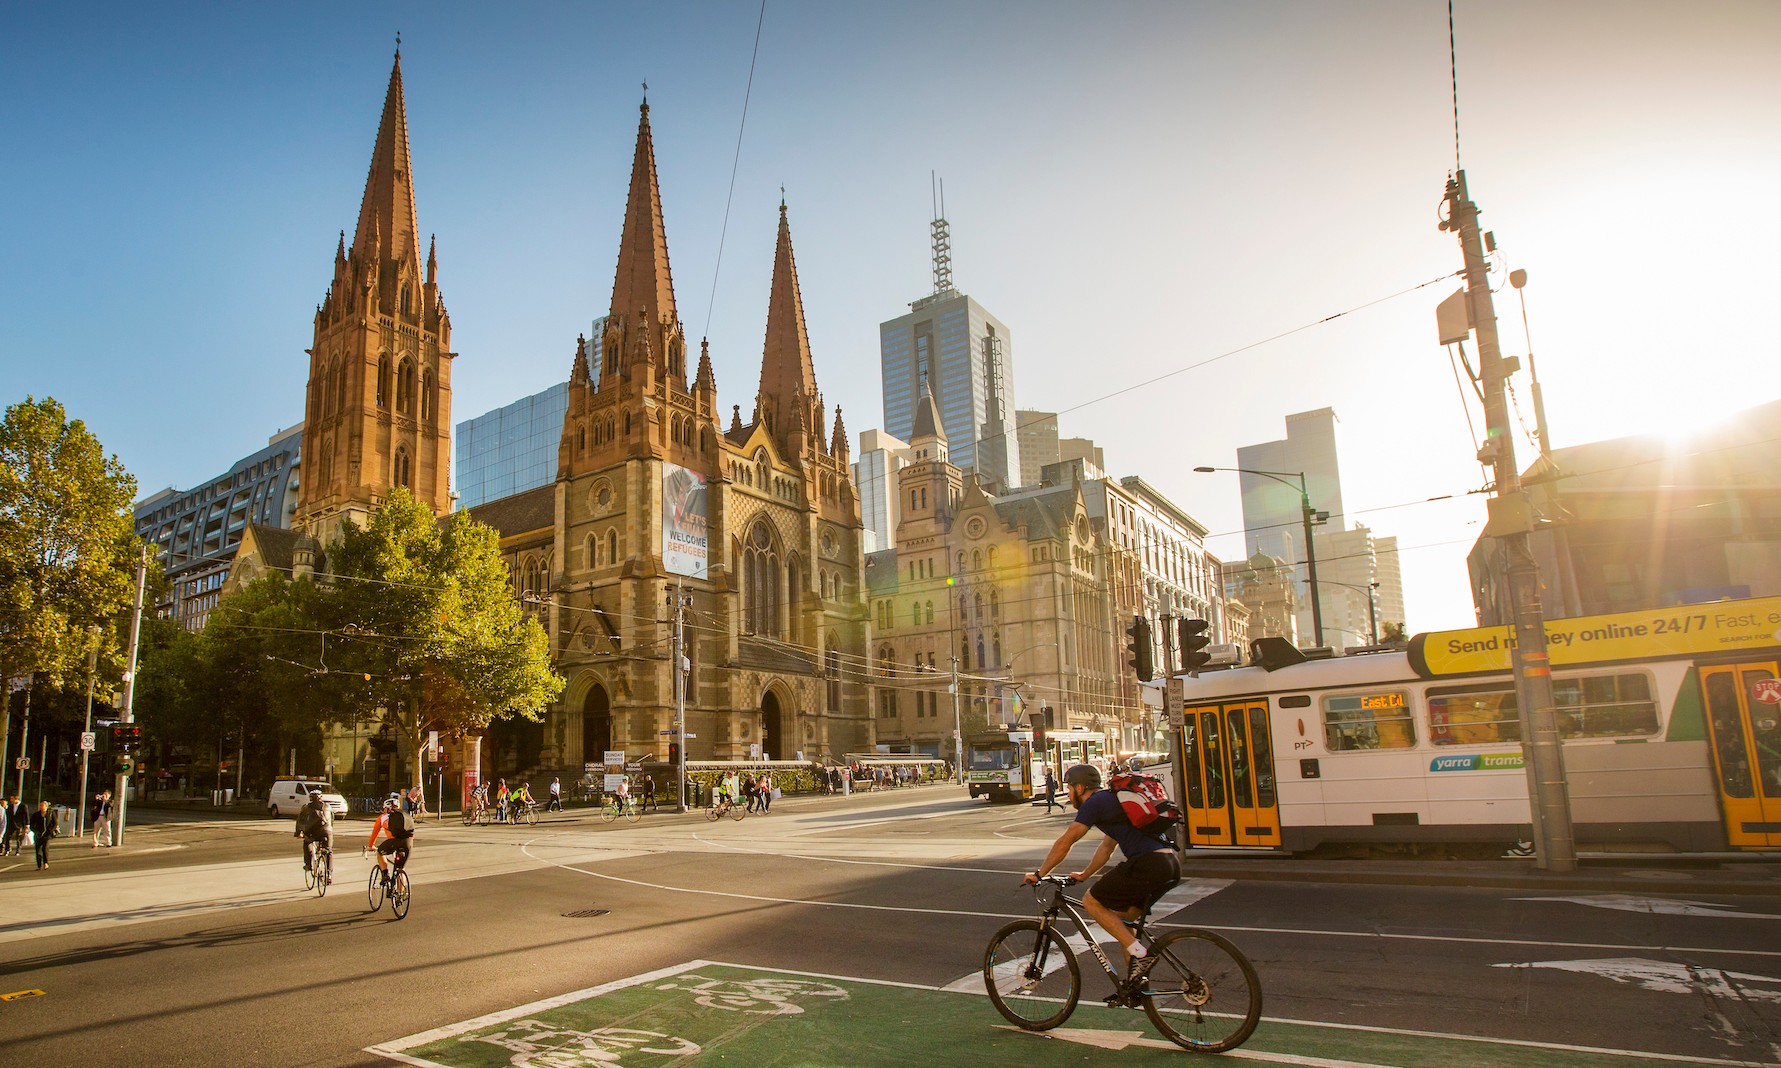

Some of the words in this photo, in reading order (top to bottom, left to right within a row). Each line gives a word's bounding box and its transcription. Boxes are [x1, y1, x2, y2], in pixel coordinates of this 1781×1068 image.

[685, 511, 707, 526] LET'S
[669, 530, 707, 548] WELCOME
[667, 541, 707, 559] REFUGEES
[1448, 635, 1498, 654] Send
[1580, 624, 1648, 642] online
[1653, 615, 1707, 635] 24/7
[1715, 612, 1761, 628] Fast,
[1720, 634, 1752, 643] SEARCH
[1755, 633, 1773, 641] FOR
[1755, 682, 1780, 692] STOP
[1361, 695, 1387, 709] East
[1436, 756, 1471, 770] yarra
[1484, 754, 1524, 767] trams
[1091, 944, 1111, 973] MARIN
